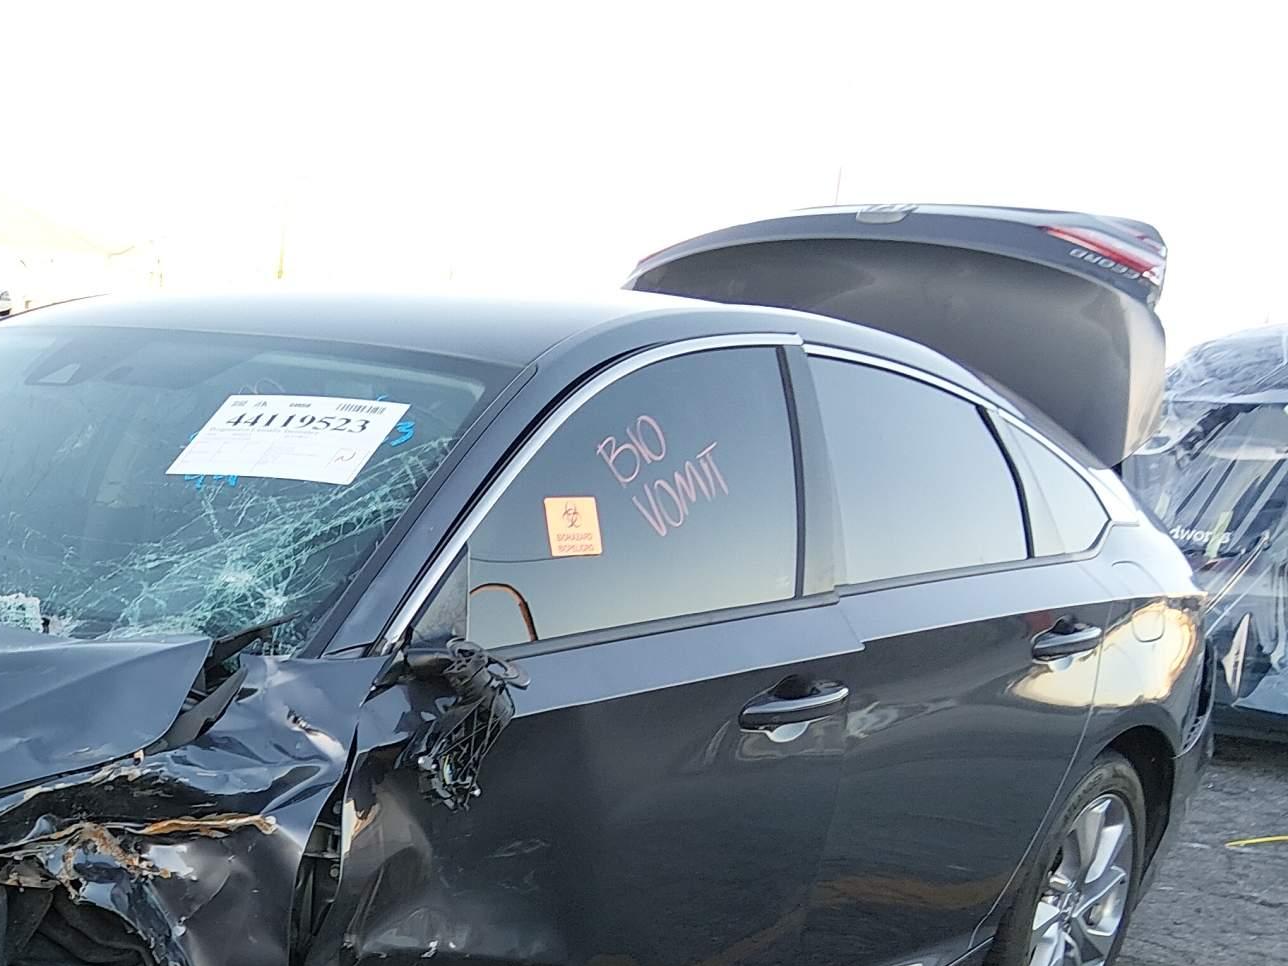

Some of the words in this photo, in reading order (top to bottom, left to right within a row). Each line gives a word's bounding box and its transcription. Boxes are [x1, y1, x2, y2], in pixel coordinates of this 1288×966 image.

[226, 412, 371, 433] 44119523
[596, 415, 666, 488] BIO
[631, 441, 729, 537] VOMIT
